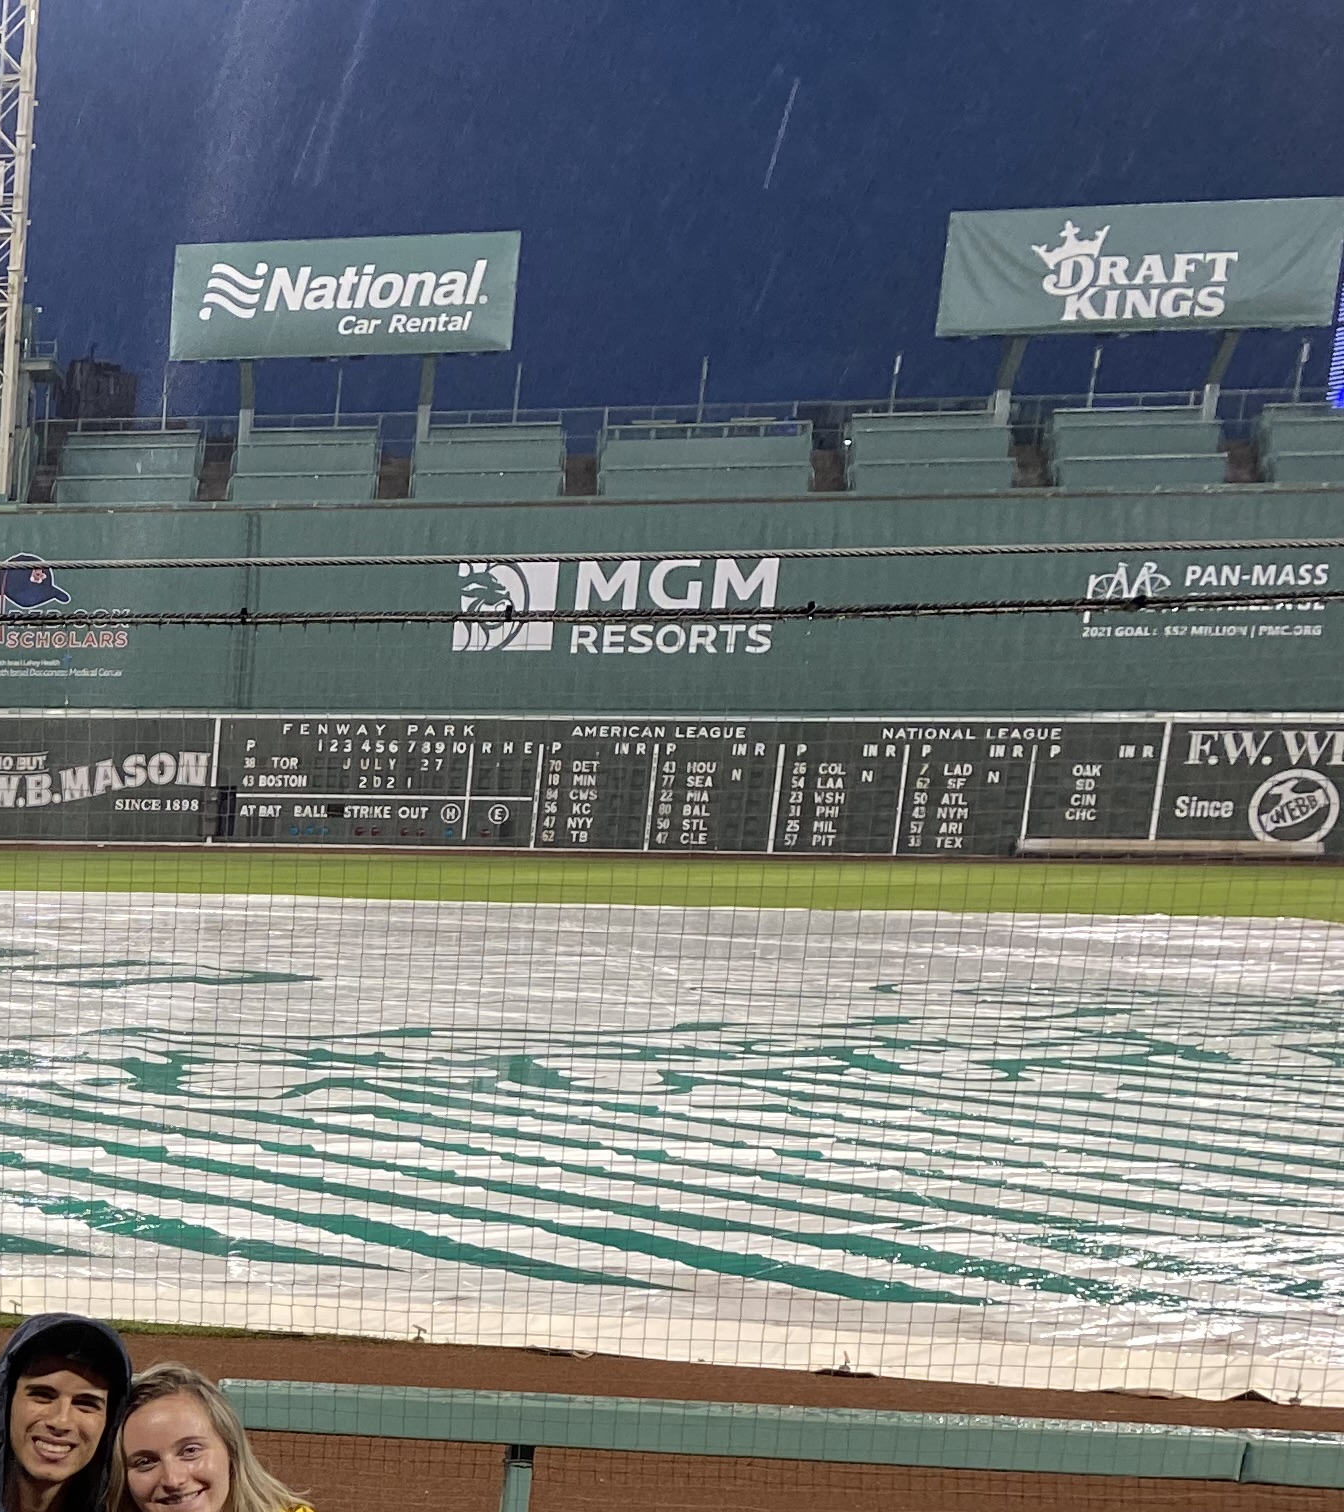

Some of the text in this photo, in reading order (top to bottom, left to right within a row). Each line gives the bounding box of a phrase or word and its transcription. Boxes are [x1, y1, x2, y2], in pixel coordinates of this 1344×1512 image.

[1042, 251, 1239, 297] DRAFT
[1060, 286, 1226, 321] KINGS
[338, 310, 472, 336] Car Rental
[1185, 563, 1329, 587] PAN-MASS
[575, 558, 780, 611] MGM
[570, 623, 773, 654] RESORTS
[1082, 626, 1112, 638] 2021
[1163, 625, 1185, 638] $52
[1190, 625, 1247, 637] MILLION
[5, 630, 129, 649] SCHOLARS
[282, 723, 475, 737] FENWAY PARK
[571, 725, 747, 739] AMERICAN LEAGUE
[882, 727, 1063, 741] NATIONAL LEAGUE
[15, 755, 47, 772] BUT
[271, 757, 299, 770] TOR
[421, 758, 444, 772] 27
[573, 760, 601, 773] DET
[686, 761, 717, 774] HOU
[818, 763, 847, 775] COL
[943, 763, 973, 776] LAD
[1072, 764, 1102, 777] OAK
[258, 774, 308, 788] BOSTON
[114, 799, 199, 811] SINCE 1898
[239, 804, 430, 820] AT BAT BALL STRIKE OUT
[572, 802, 592, 815] KC
[1174, 795, 1235, 819] Since
[1268, 794, 1320, 825] WEBB
